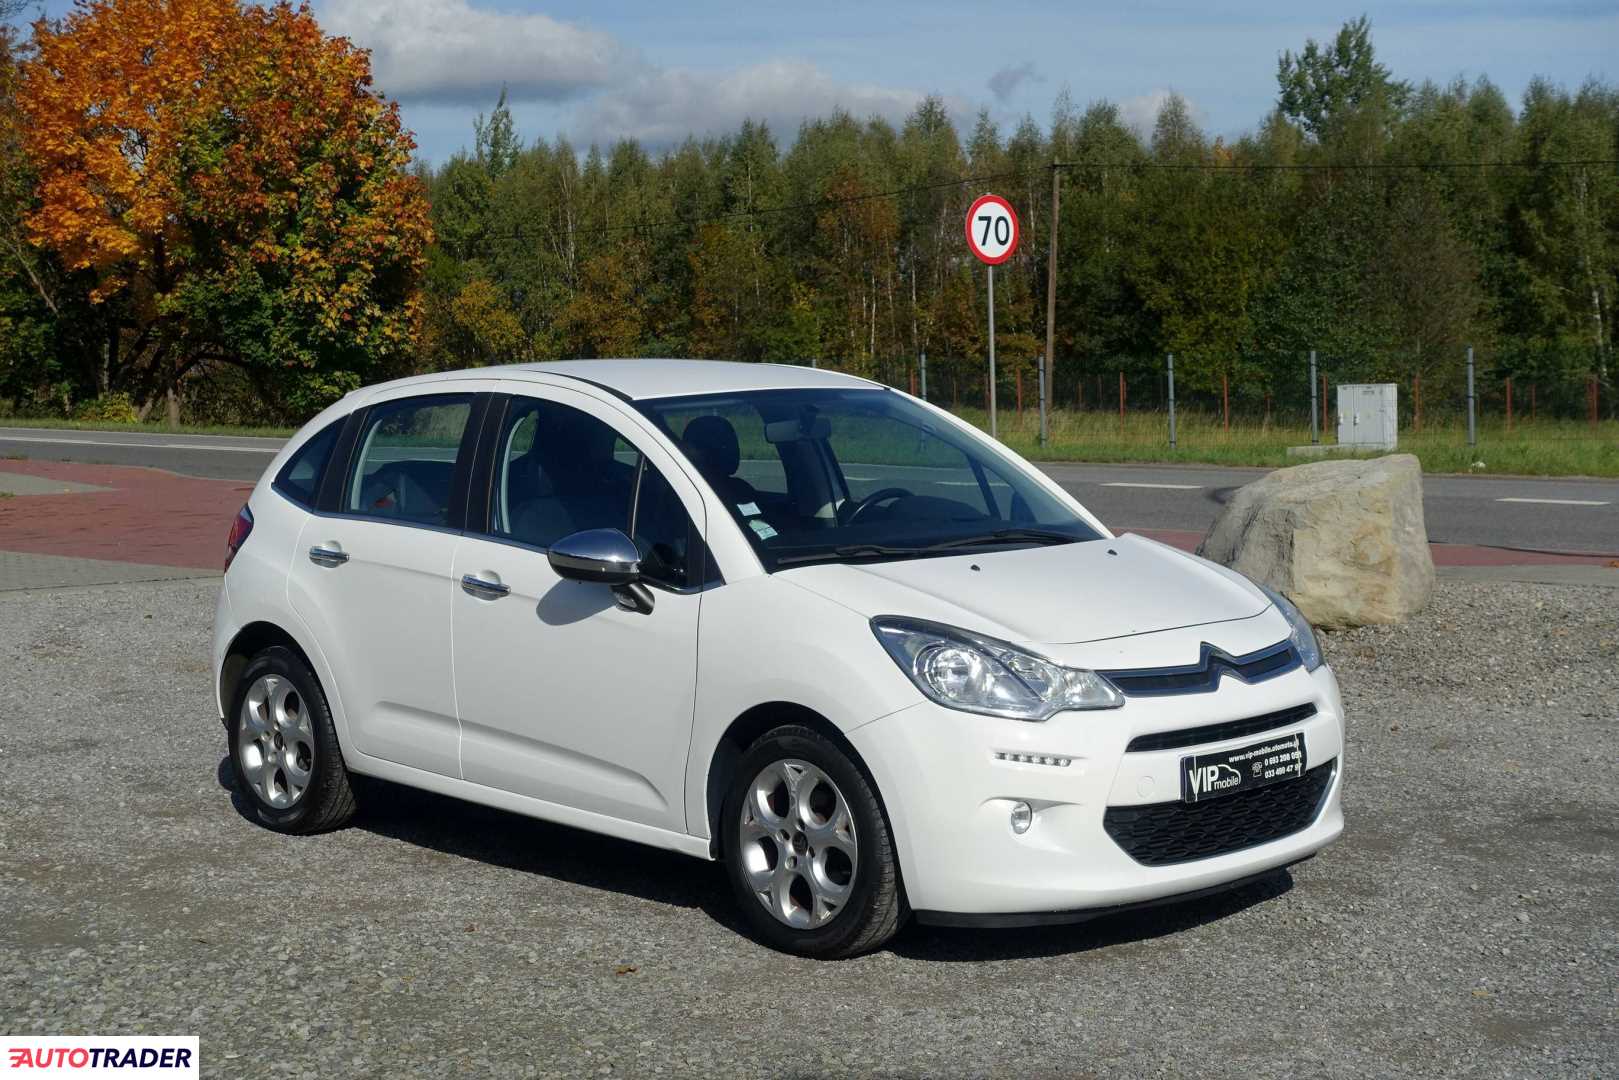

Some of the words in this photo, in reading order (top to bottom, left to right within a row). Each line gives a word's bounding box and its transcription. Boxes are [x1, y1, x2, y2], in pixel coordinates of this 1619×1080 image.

[978, 216, 1010, 246] 70
[1286, 764, 1294, 773] 47
[1189, 765, 1219, 798] VIP
[1214, 775, 1239, 790] mobile
